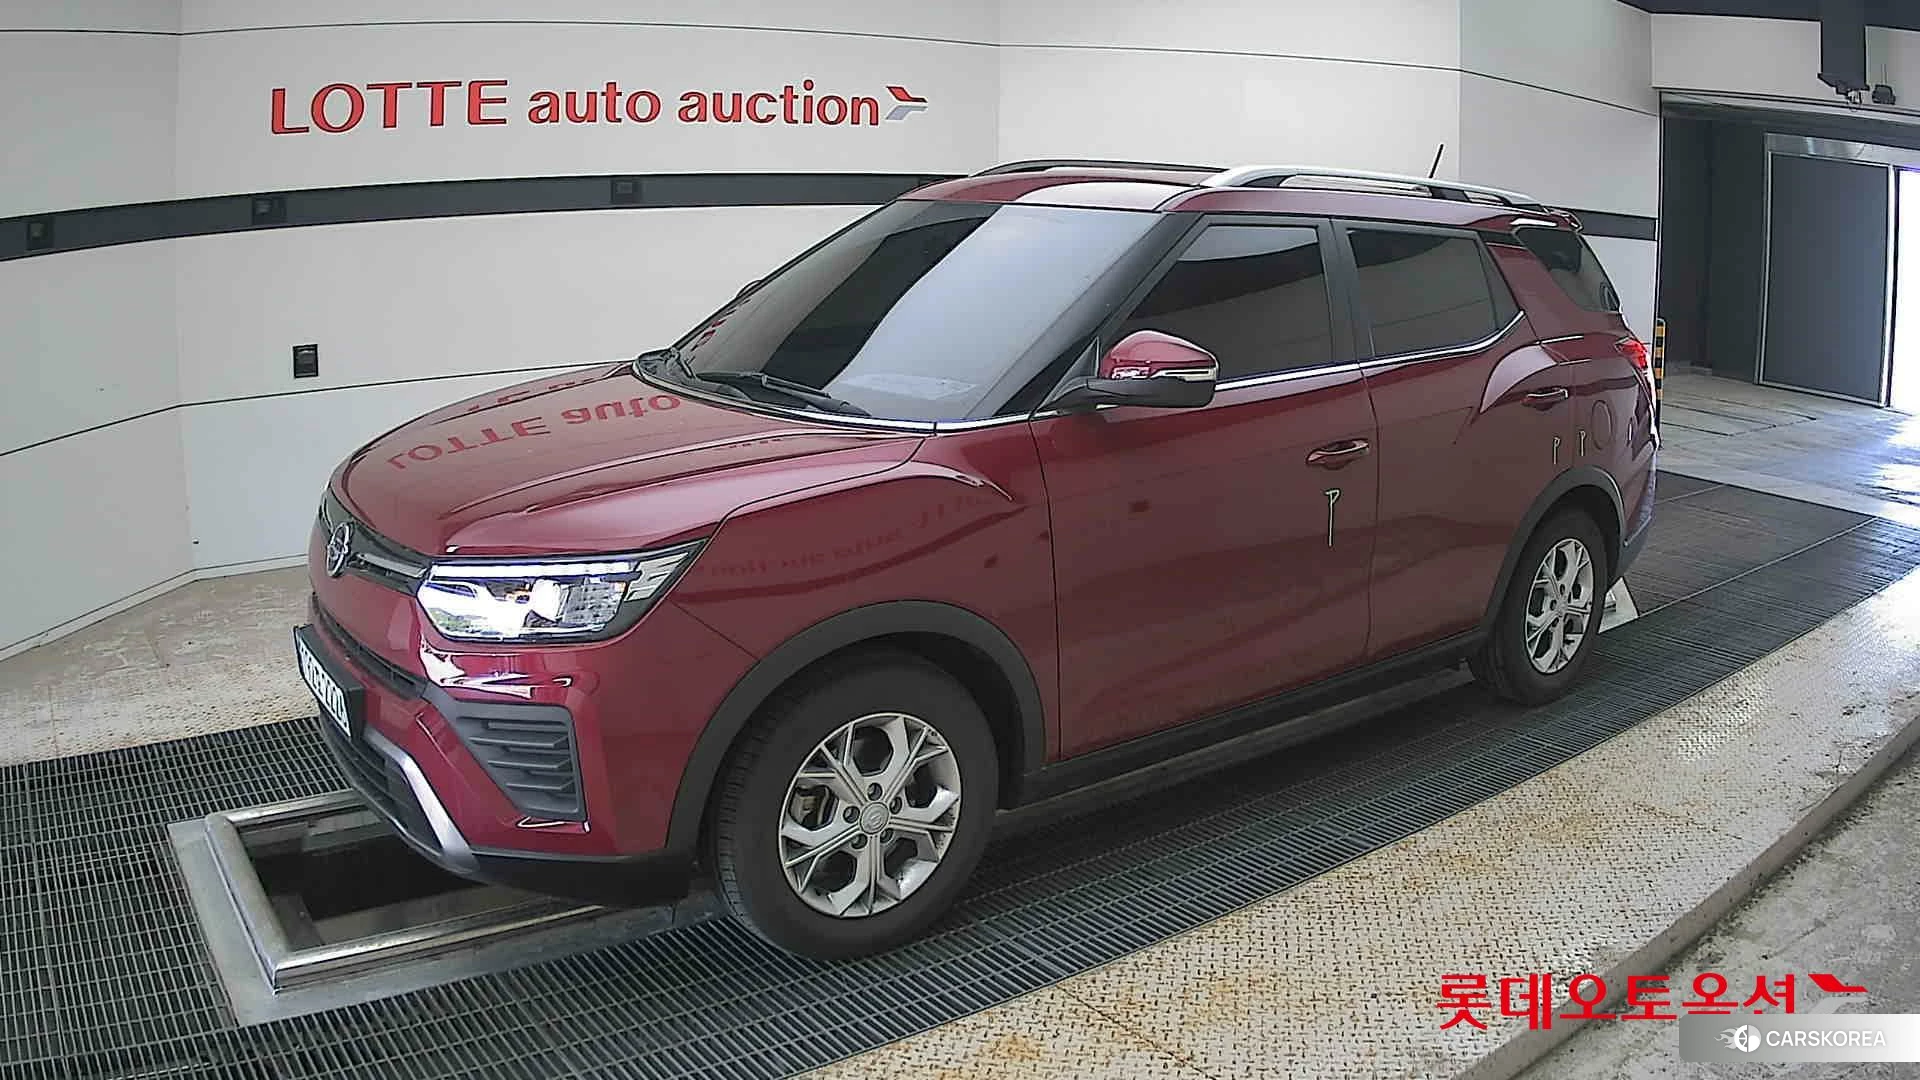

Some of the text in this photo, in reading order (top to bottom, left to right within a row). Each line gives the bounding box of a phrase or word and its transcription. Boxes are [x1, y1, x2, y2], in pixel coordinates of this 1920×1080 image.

[271, 79, 879, 135] LOTTE auto auction
